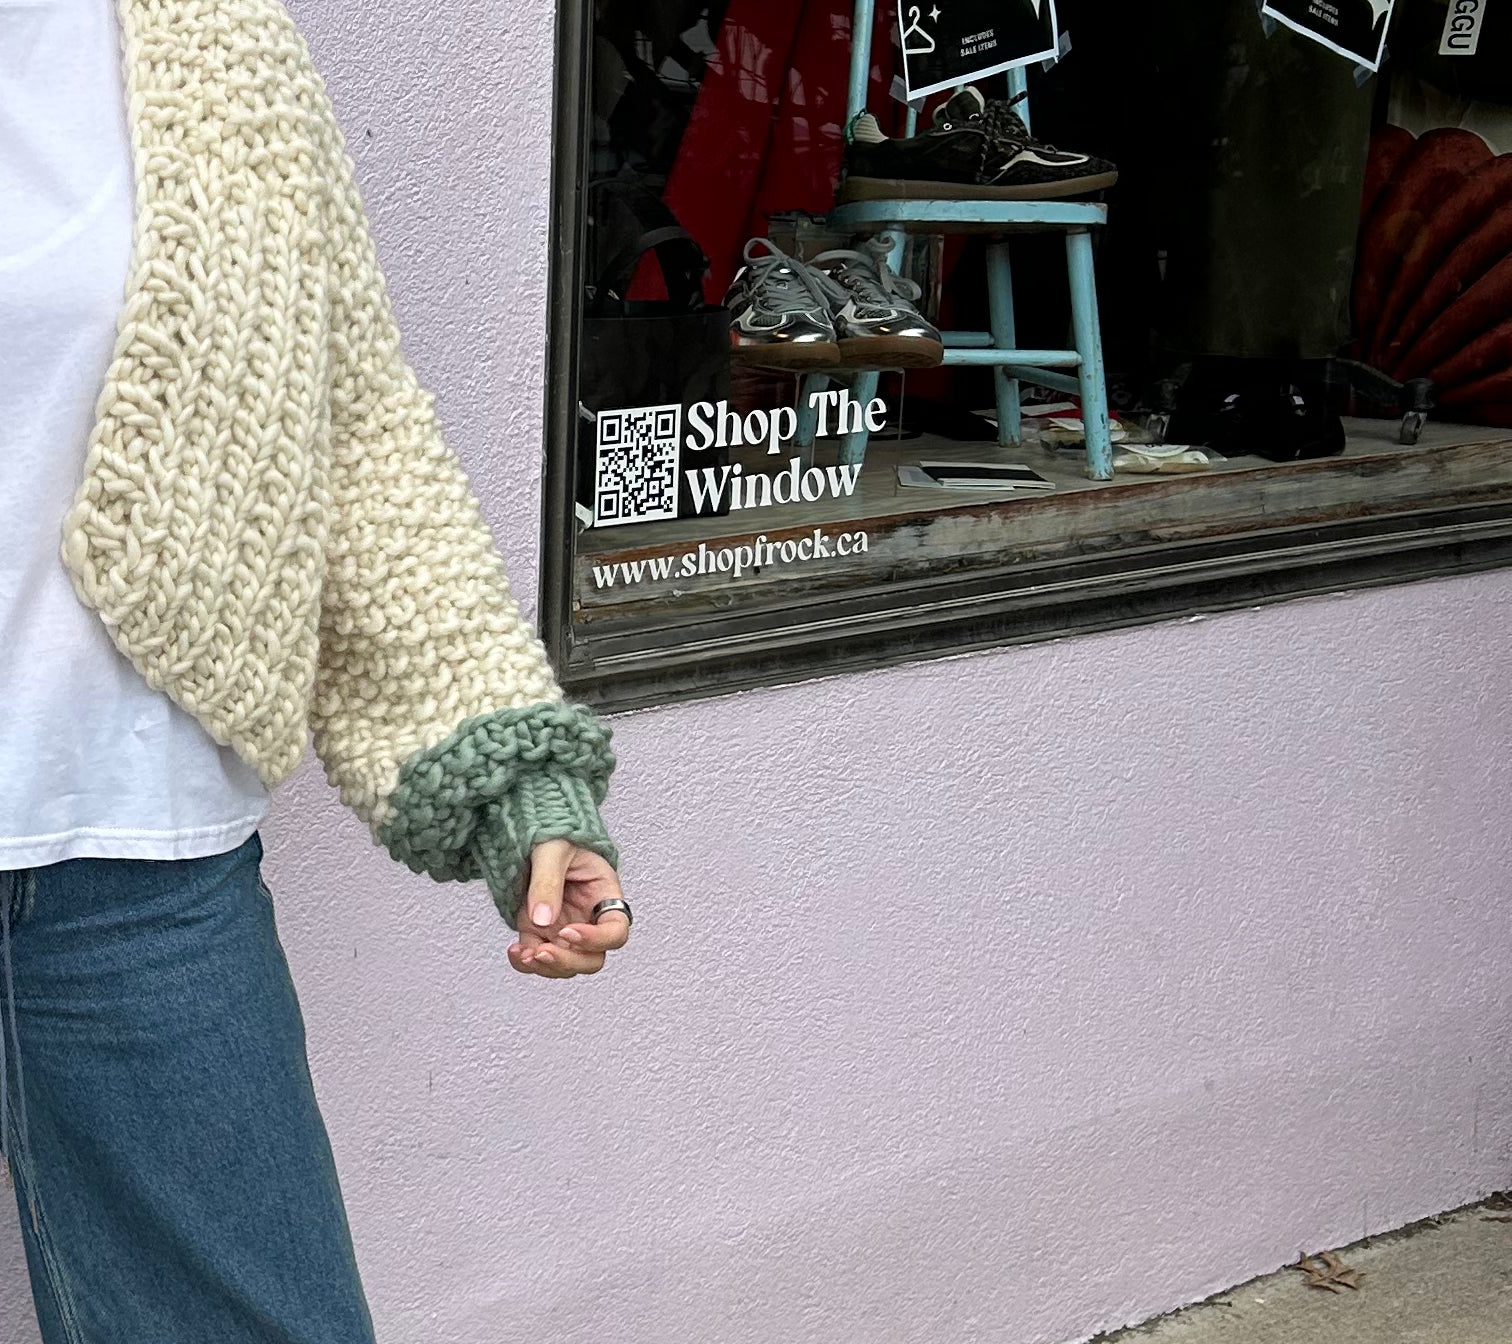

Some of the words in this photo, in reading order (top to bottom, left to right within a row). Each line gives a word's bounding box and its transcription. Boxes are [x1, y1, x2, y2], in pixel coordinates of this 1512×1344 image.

[686, 400, 797, 455] Shop
[809, 389, 887, 437] The
[685, 457, 862, 515] Window
[592, 529, 870, 589] www.shopfrock.ca
